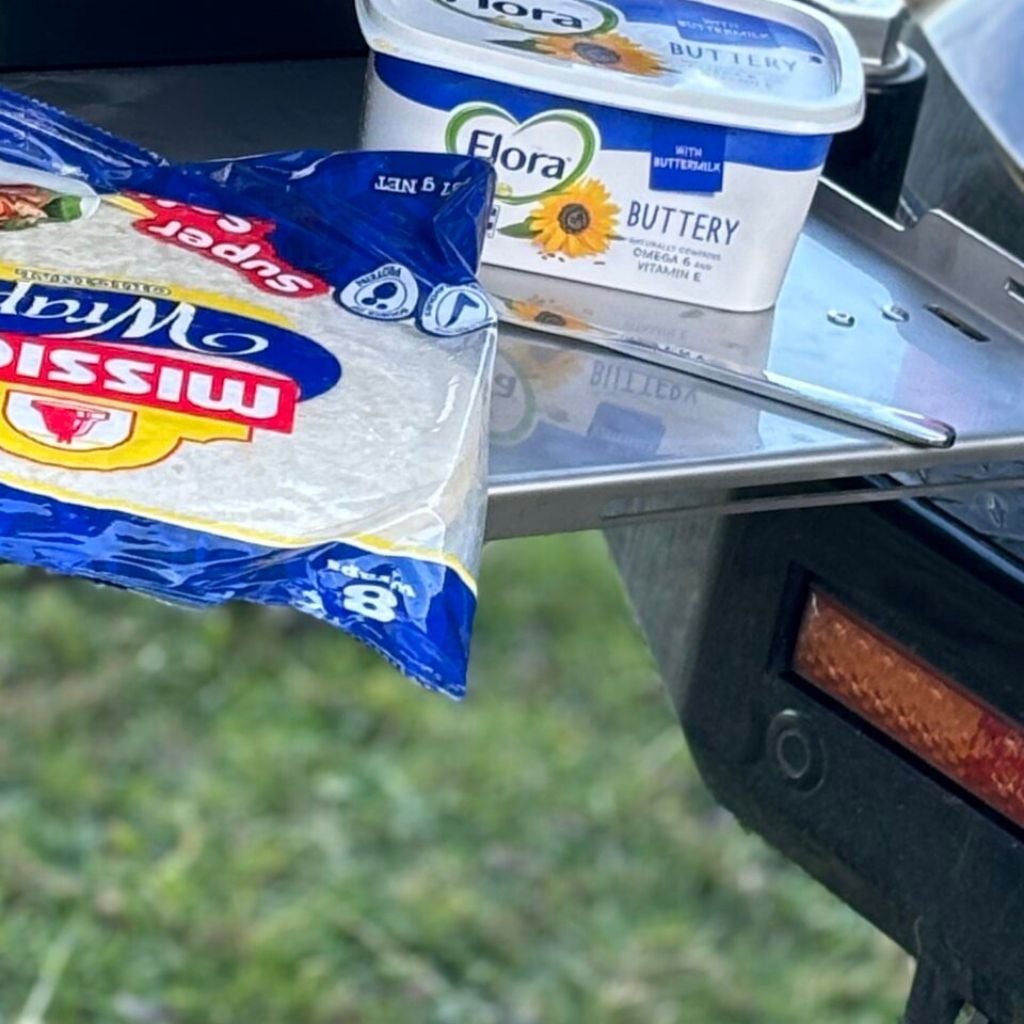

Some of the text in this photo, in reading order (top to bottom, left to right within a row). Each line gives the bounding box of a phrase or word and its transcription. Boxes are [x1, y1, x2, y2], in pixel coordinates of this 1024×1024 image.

[669, 41, 797, 73] BUTTERY
[467, 129, 566, 180] Flora
[653, 156, 721, 173] BUTTERMILK
[675, 145, 702, 158] WITH
[374, 175, 418, 194] NET
[627, 200, 740, 246] BUTTERY
[148, 220, 314, 293] Super
[632, 247, 678, 265] OMEGA
[682, 256, 691, 268] 6
[637, 262, 702, 282] VITAMIN E
[343, 584, 398, 623] 8
